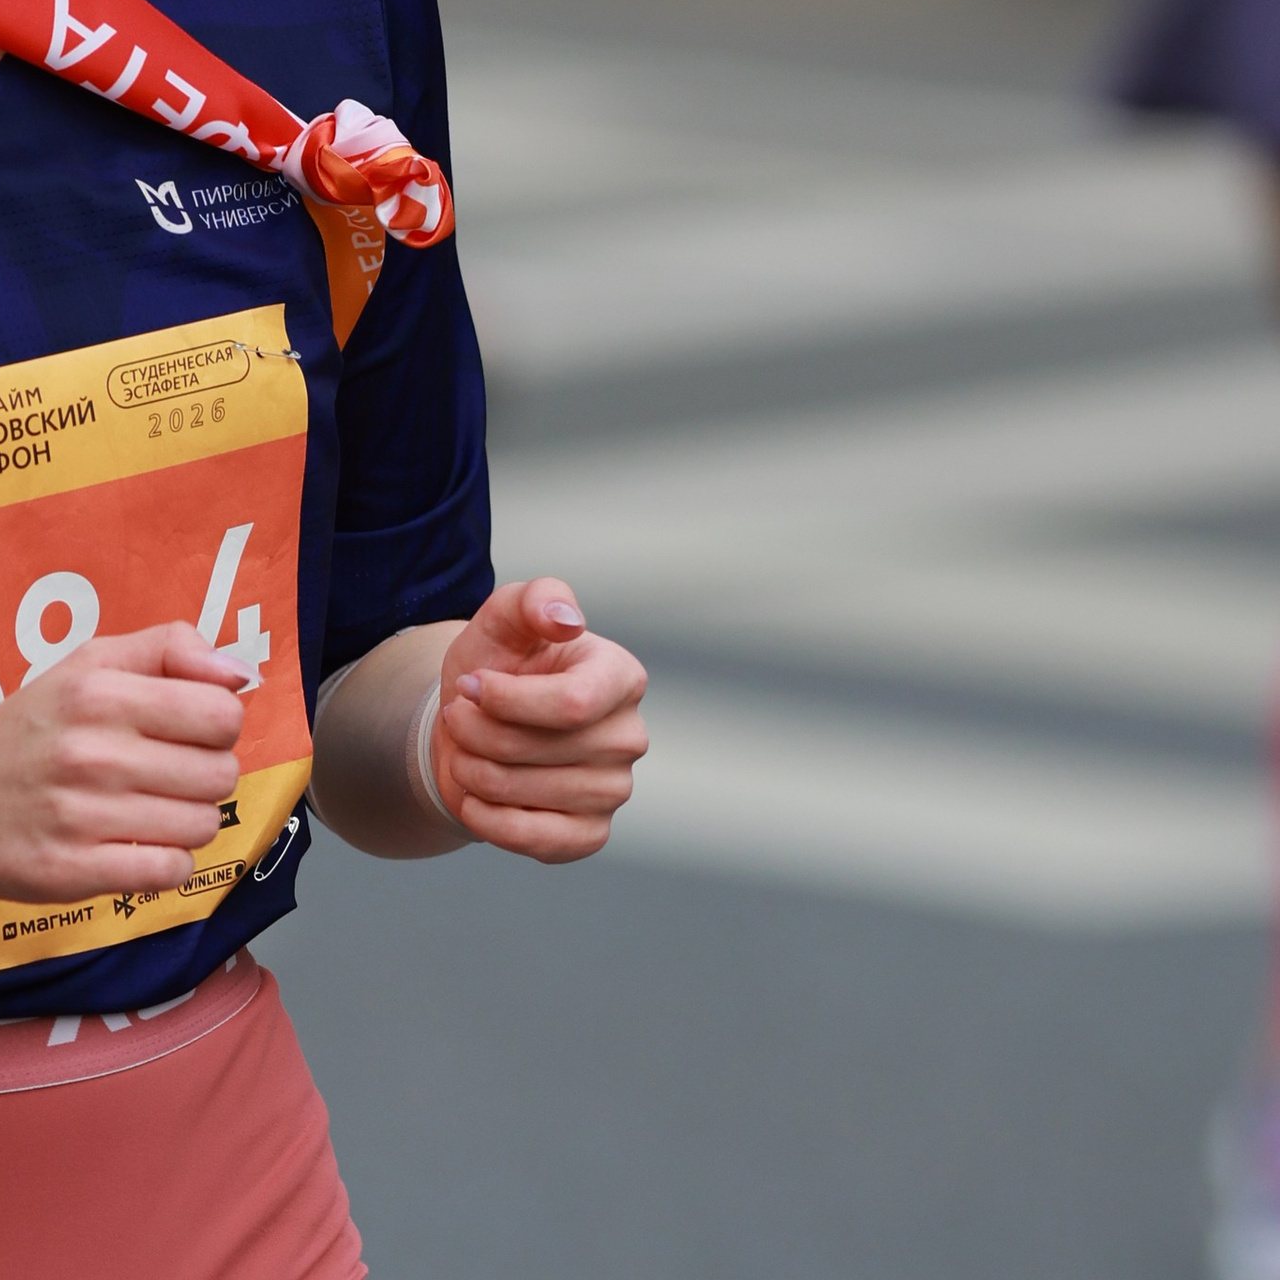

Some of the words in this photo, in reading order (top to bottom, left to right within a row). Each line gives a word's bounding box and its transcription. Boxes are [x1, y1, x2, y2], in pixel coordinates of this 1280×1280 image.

[120, 346, 234, 386] СТУДЕНЧЕСКАЯ
[124, 372, 200, 402] ЭСТАФЕТА
[148, 396, 226, 439] 2026
[183, 867, 233, 893] WINLINE
